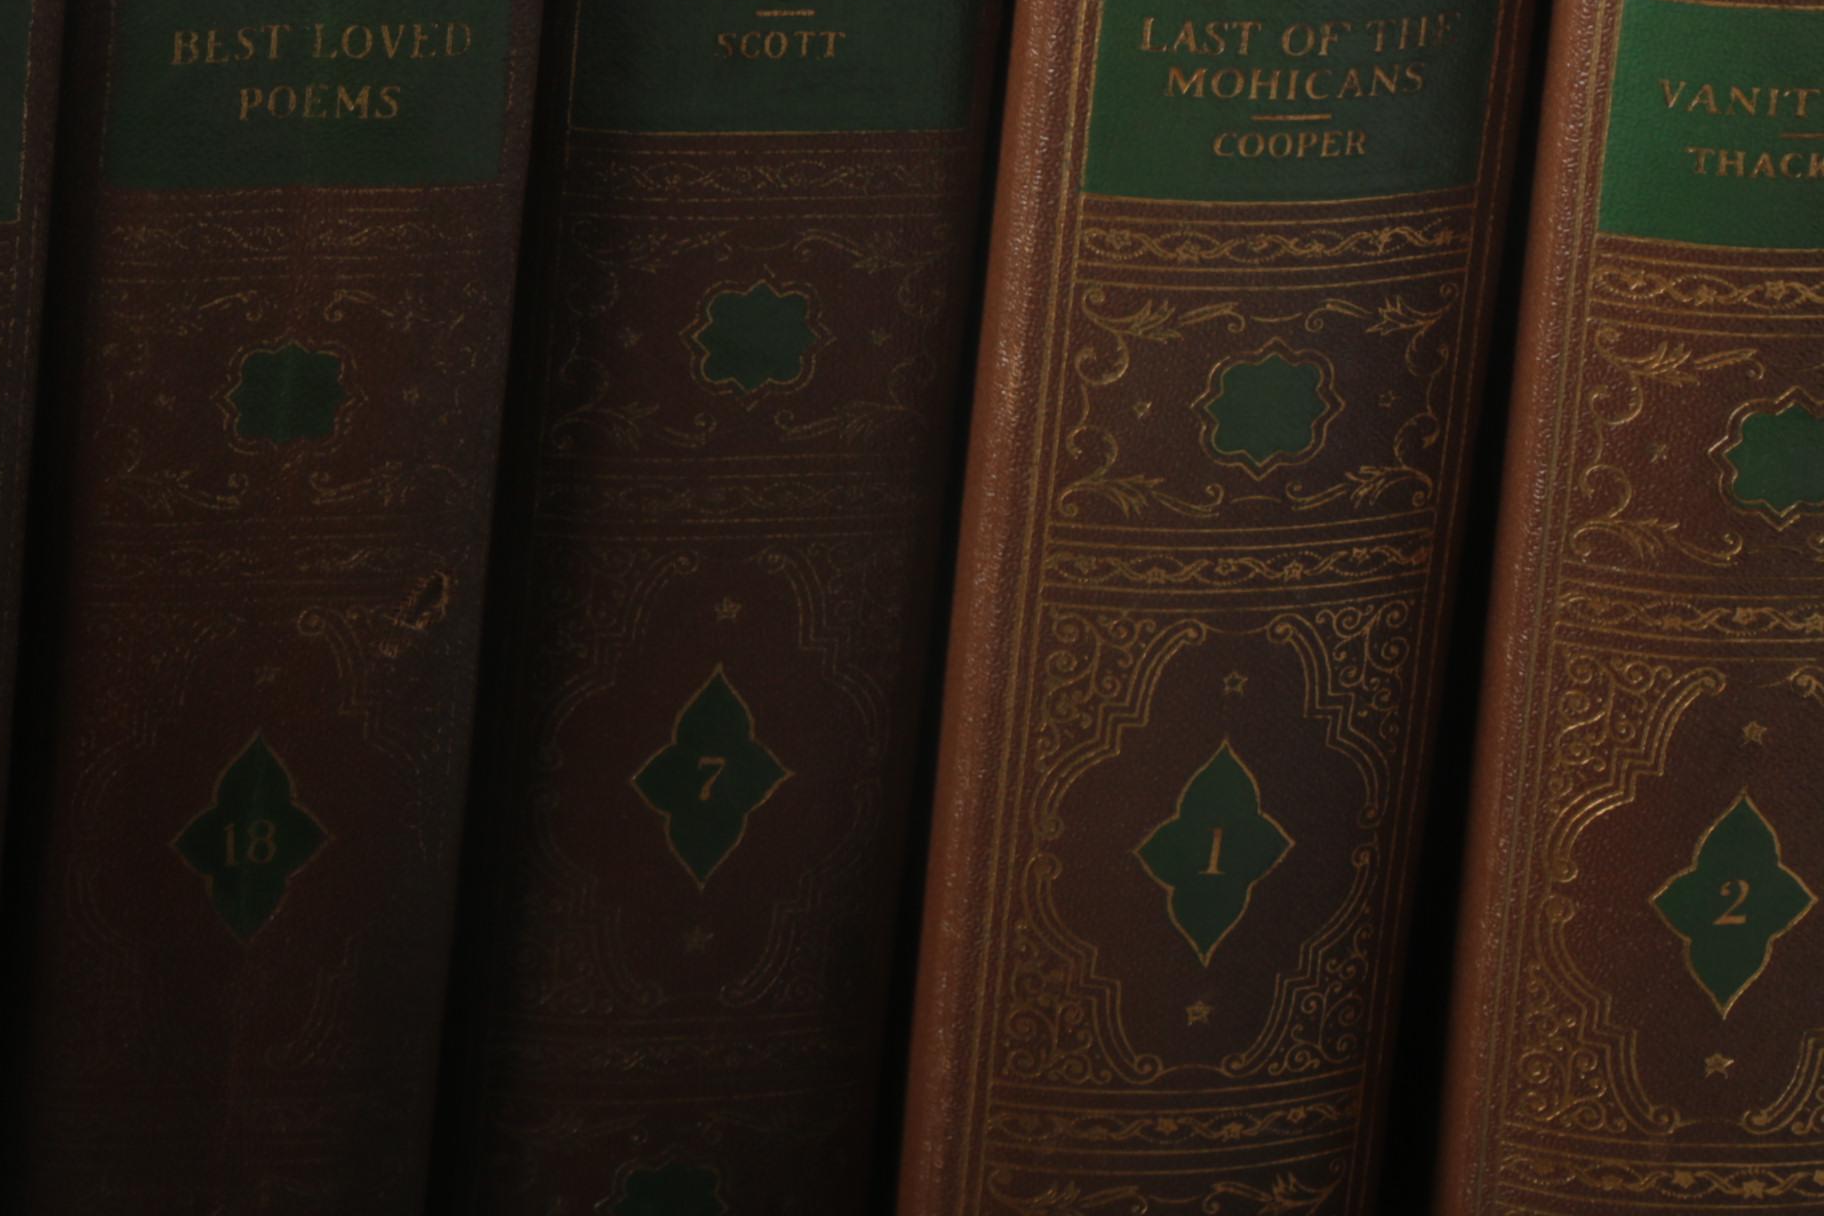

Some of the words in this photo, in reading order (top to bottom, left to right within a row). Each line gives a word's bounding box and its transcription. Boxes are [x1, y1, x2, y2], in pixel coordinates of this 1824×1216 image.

[171, 22, 291, 65] BEST
[308, 22, 473, 60] LOVED
[714, 31, 846, 60] SCOTT
[1139, 16, 1262, 56] LAST
[1281, 20, 1352, 58] OF
[1367, 11, 1462, 53] THE
[239, 85, 401, 121] POEMS
[1164, 62, 1425, 101] MOHICANS
[1658, 79, 1822, 119] VANIT
[1212, 130, 1369, 159] COOPER
[697, 756, 726, 801] 7
[224, 819, 276, 867] 18
[1199, 827, 1225, 875] 1
[1712, 880, 1751, 926] 2
